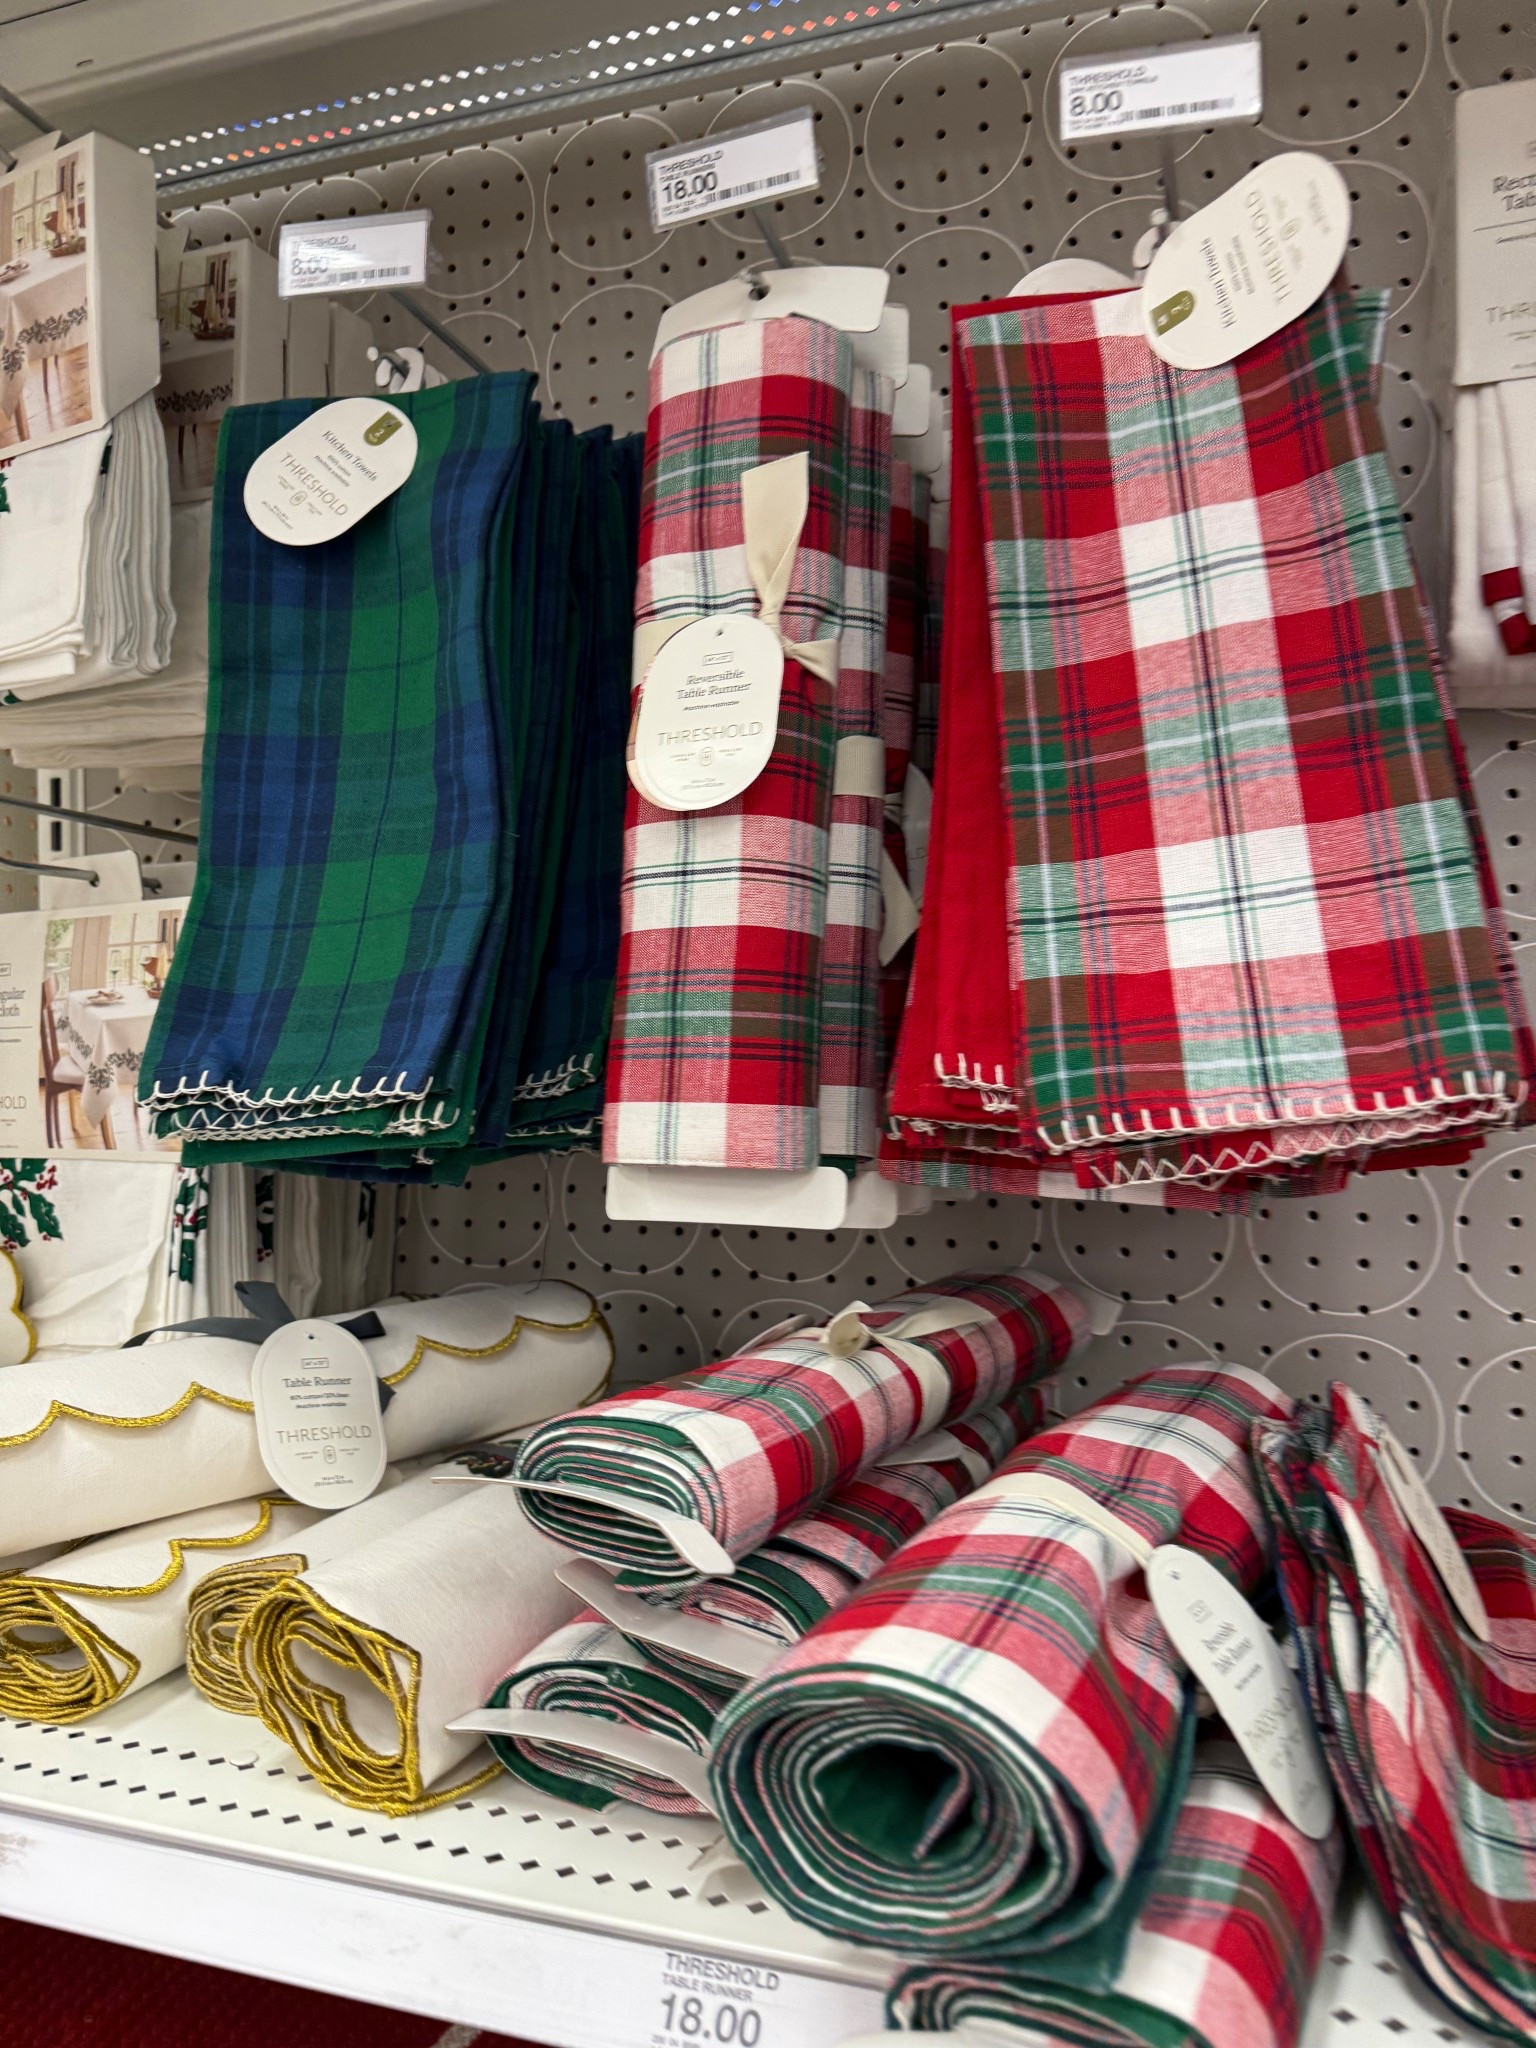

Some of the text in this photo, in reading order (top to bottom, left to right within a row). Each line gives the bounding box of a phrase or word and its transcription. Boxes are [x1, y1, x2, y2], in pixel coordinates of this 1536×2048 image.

[1070, 90, 1123, 116] 8.00
[661, 171, 718, 203] 18.00
[322, 430, 377, 481] Kitchen Towels
[280, 452, 349, 515] THRESHOLD
[676, 682, 753, 700] Table Runner
[657, 721, 763, 746] THRESHOLD
[282, 1376, 352, 1388] Table Runner
[275, 1424, 372, 1444] THRESHOLD
[666, 1951, 780, 1991] THRESHOLD
[661, 1972, 753, 2002] TABLE RUNNER
[660, 1993, 762, 2048] 18.00
